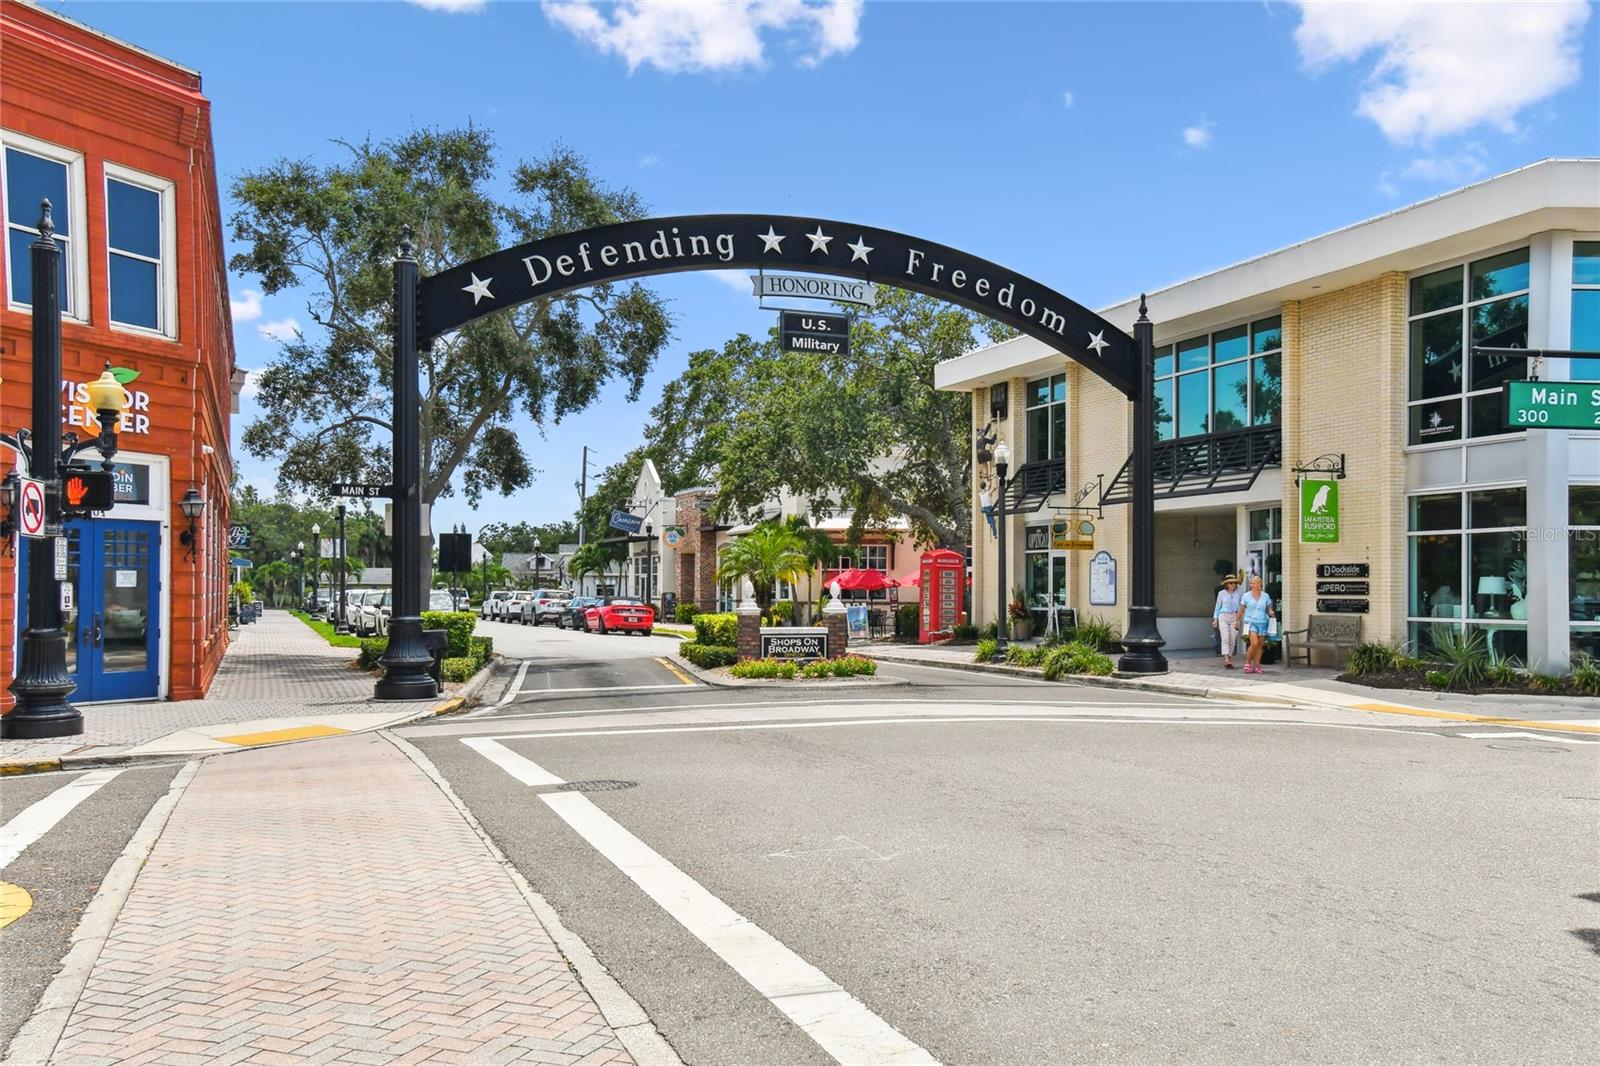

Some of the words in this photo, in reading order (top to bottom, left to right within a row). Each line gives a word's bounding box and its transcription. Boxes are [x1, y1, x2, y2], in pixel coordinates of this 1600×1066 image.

[521, 227, 735, 287] Defending
[905, 248, 1067, 336] Freedom
[769, 276, 865, 300] HONORING
[801, 318, 831, 331] U.S.
[791, 336, 840, 353] Military
[1531, 387, 1578, 406] Main
[1591, 389, 1600, 407] S
[61, 404, 150, 435] ENER
[1518, 409, 1548, 423] 300
[341, 486, 364, 495] MAIN
[368, 487, 381, 496] ST
[1331, 565, 1360, 574] Dockside
[770, 637, 802, 646] SHOPS
[803, 637, 819, 646] ON
[768, 645, 820, 653] BROADWAY
